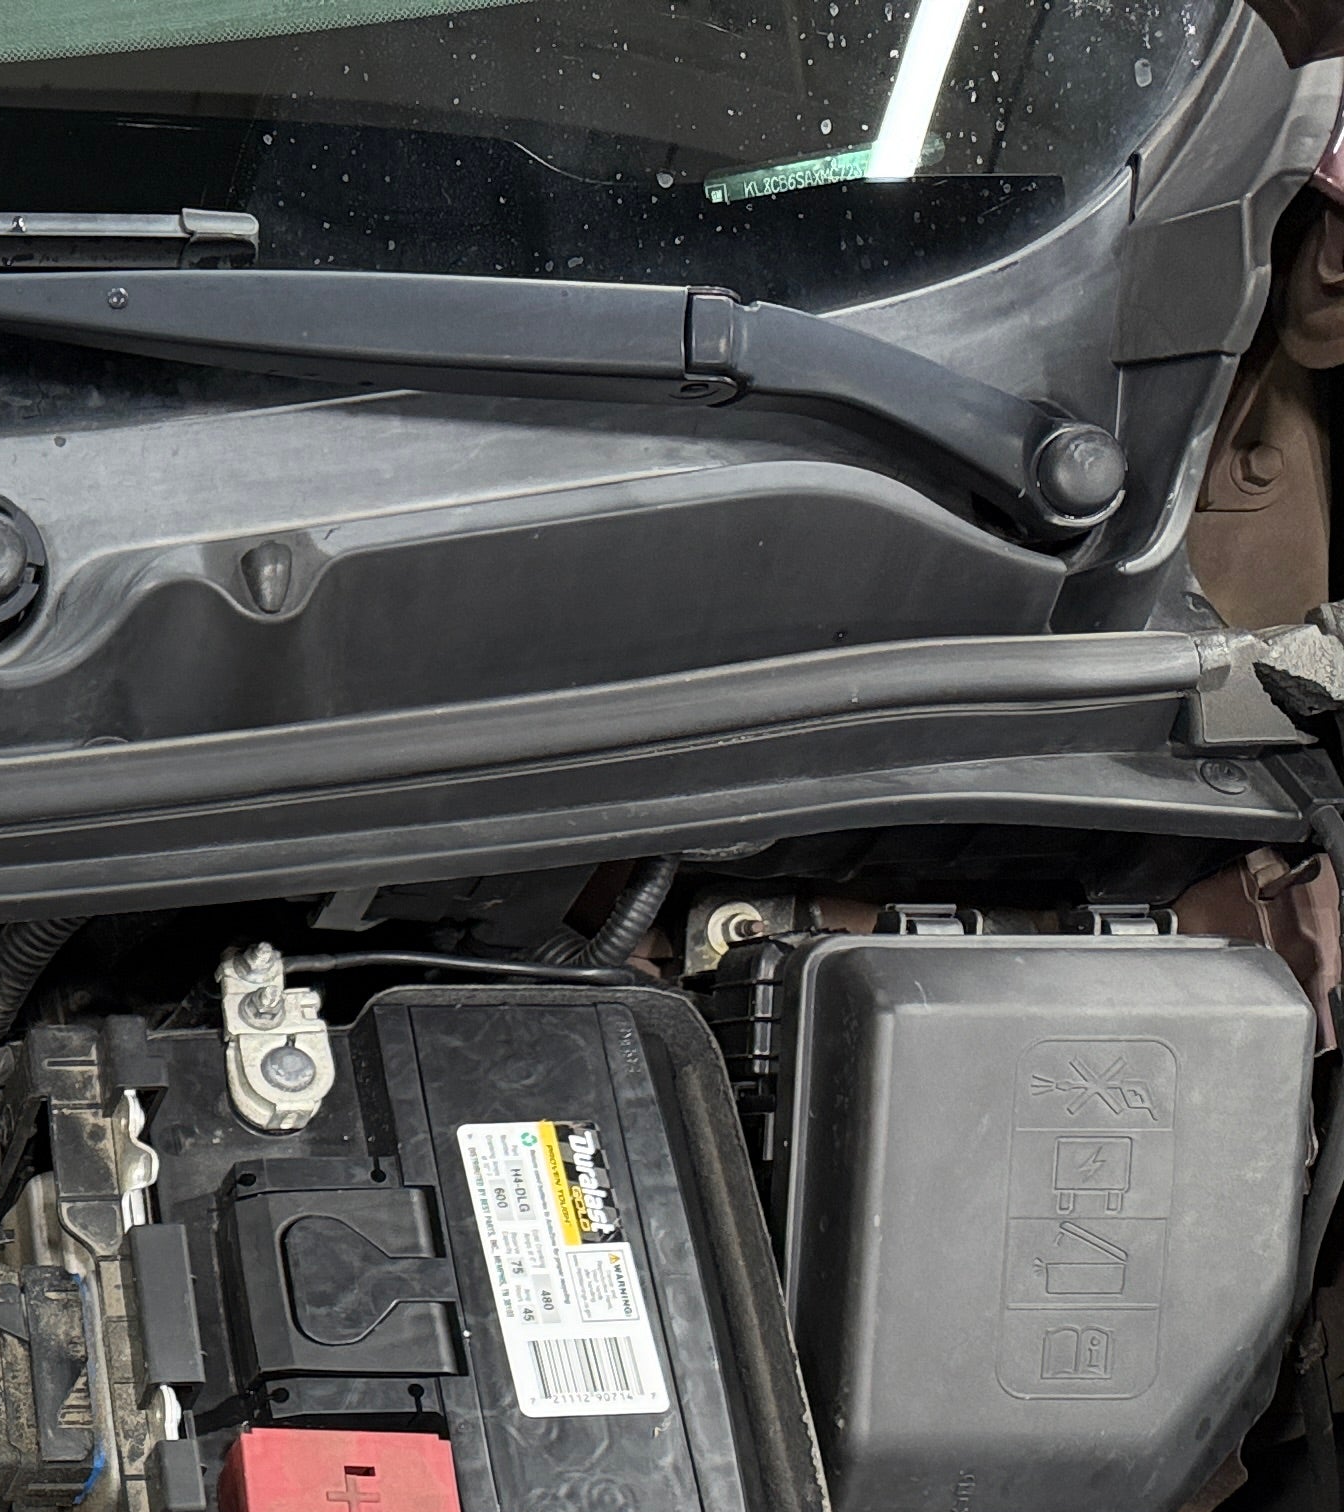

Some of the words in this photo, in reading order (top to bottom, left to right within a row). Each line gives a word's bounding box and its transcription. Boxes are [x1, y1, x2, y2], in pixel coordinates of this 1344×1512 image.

[510, 1168, 530, 1213] H4-DLG
[568, 1131, 615, 1234] Duralast
[494, 1187, 508, 1208] 600
[571, 1186, 591, 1232] GOLD
[511, 1261, 524, 1274] 75
[541, 1290, 554, 1311] 480
[523, 1308, 535, 1321] 45
